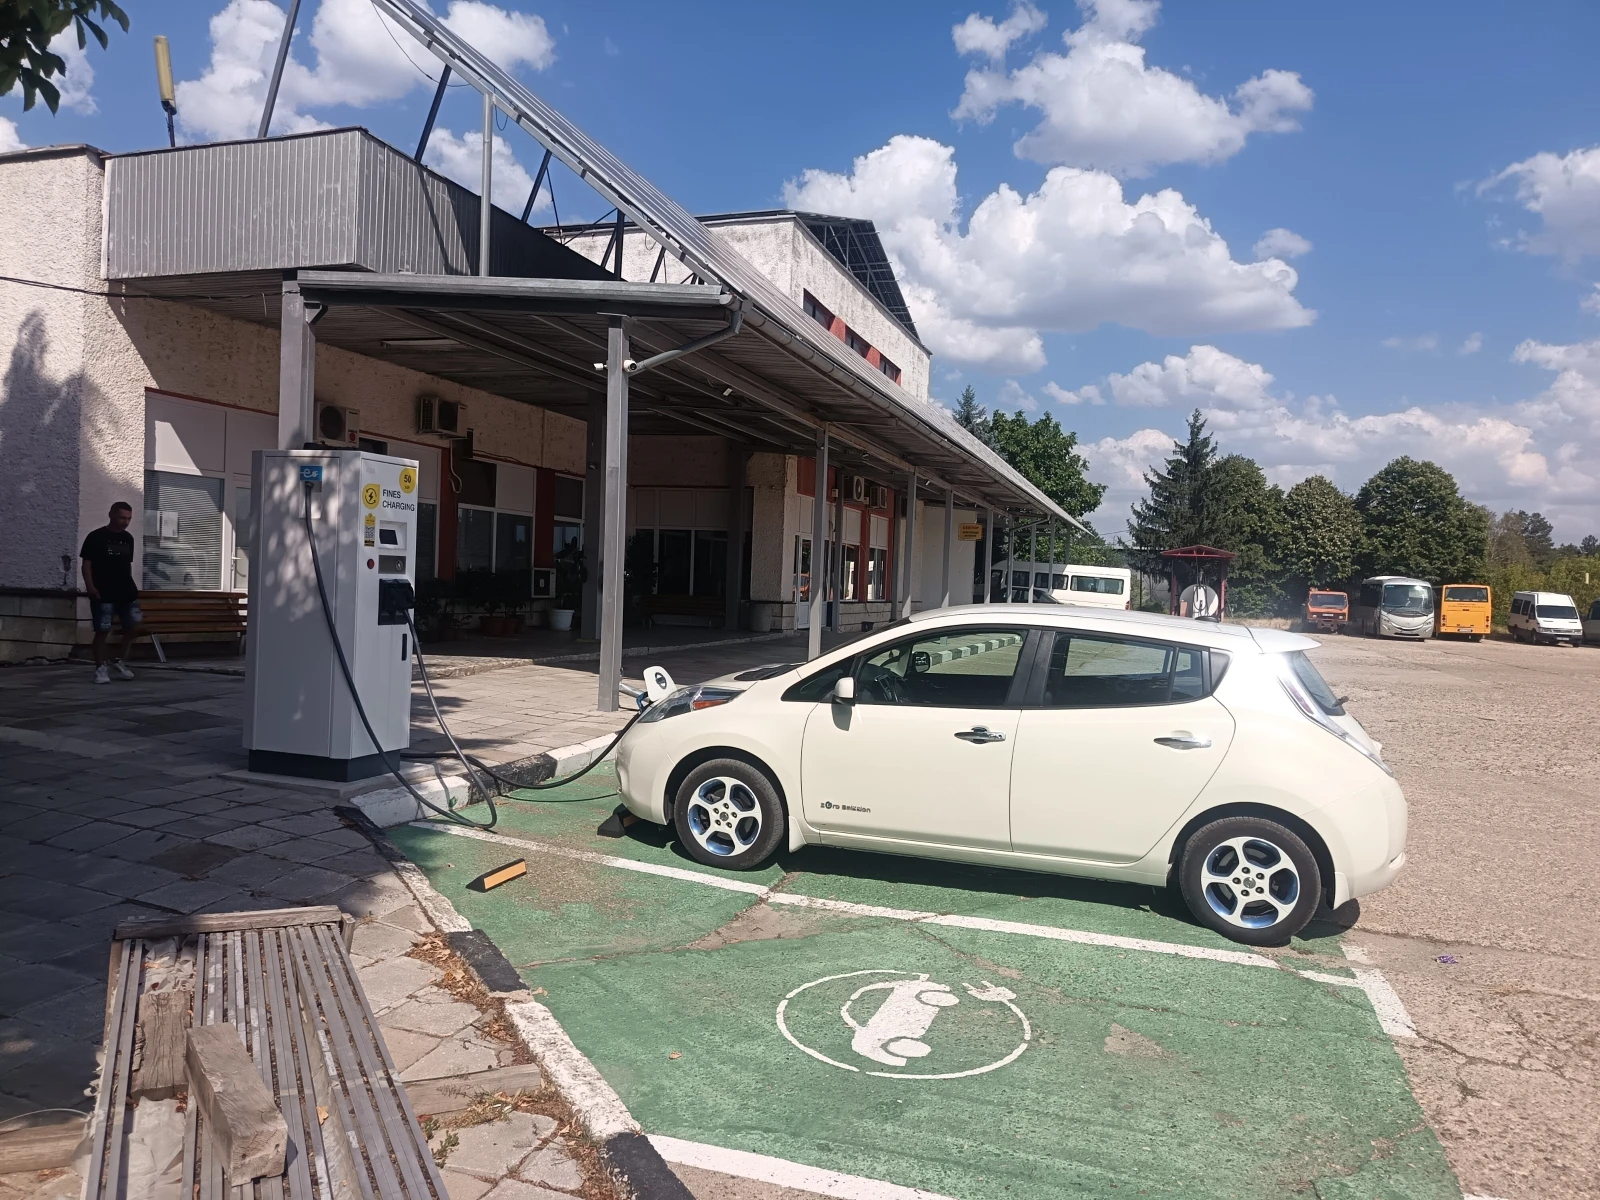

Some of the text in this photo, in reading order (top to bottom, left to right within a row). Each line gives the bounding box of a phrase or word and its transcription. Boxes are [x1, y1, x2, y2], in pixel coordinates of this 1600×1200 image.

[404, 475, 411, 483] 50
[382, 489, 401, 498] FINES
[382, 501, 415, 511] CHARGING
